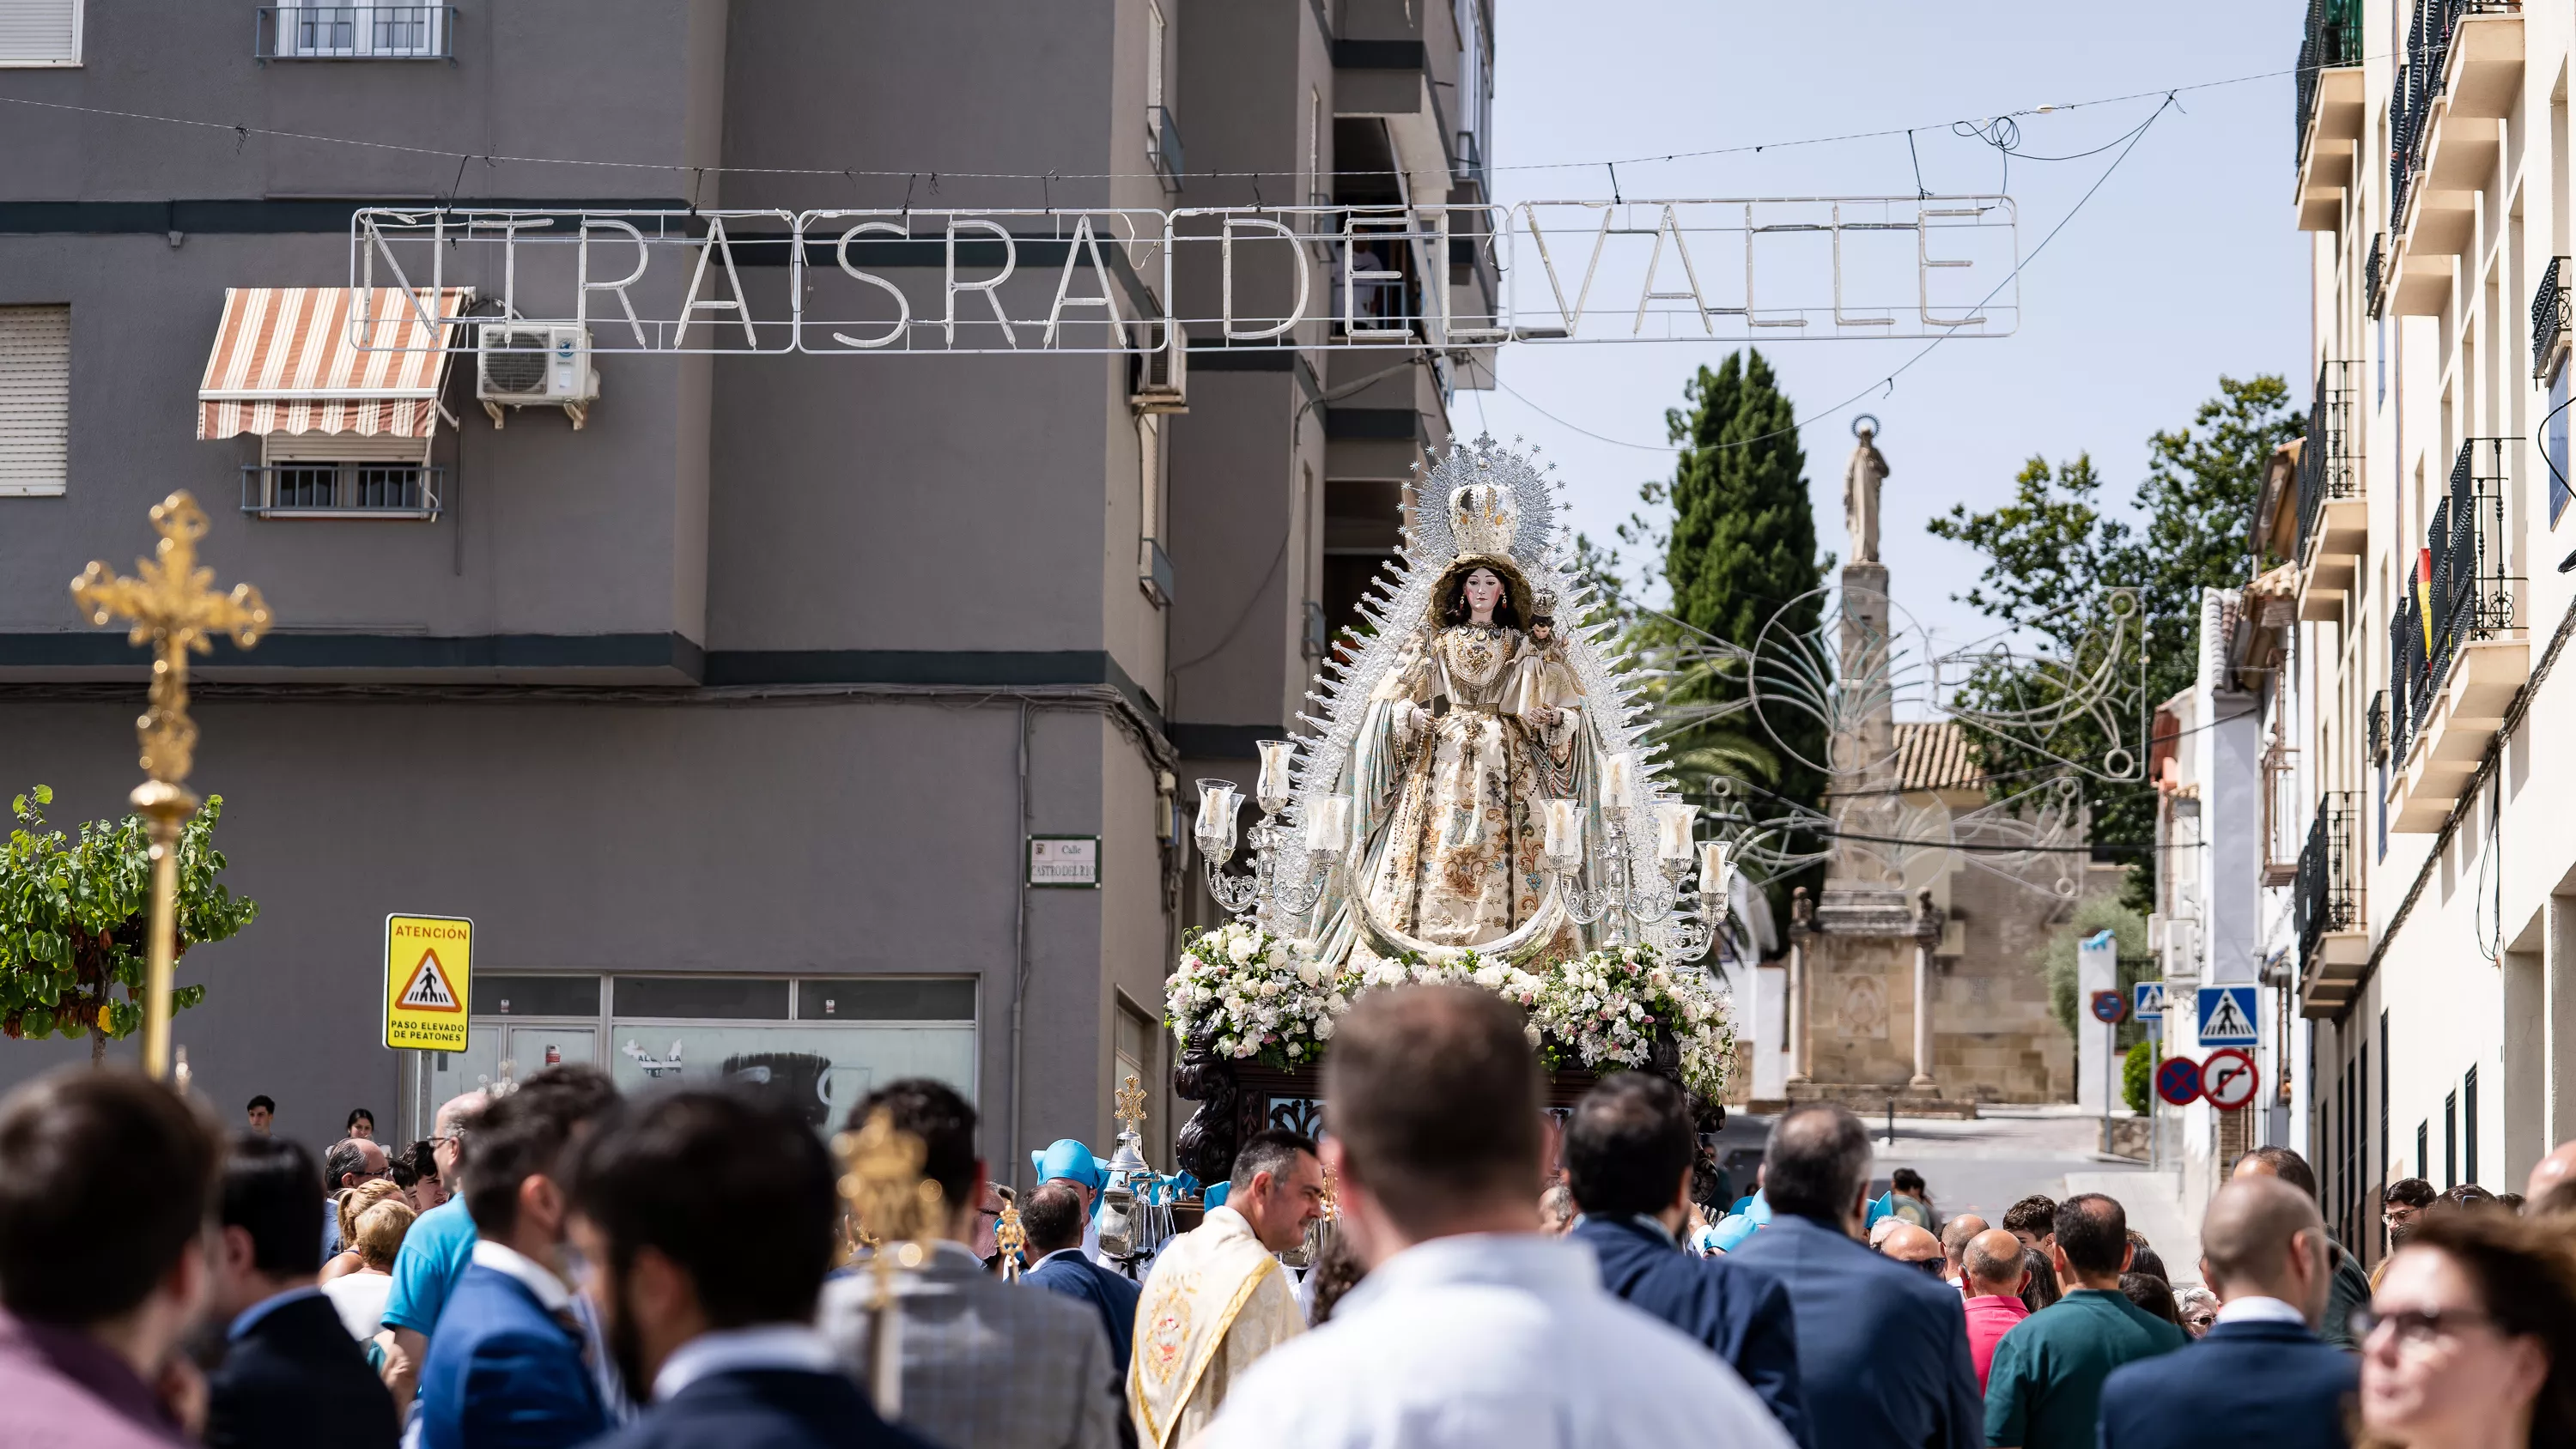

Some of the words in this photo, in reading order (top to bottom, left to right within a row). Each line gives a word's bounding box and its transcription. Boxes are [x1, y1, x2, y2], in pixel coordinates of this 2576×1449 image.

[363, 213, 756, 349] NTRA
[832, 214, 1128, 349] SRA
[1223, 211, 1508, 341] DEL
[1523, 204, 1988, 338] VALLE
[1061, 845, 1081, 854] Calle
[1031, 864, 1060, 876] CASTRO
[1062, 864, 1079, 876] DEL
[395, 925, 468, 940] ATENCIÓN
[391, 1020, 417, 1029] PASO
[421, 1022, 465, 1033] ELEVADO
[393, 1030, 406, 1039] DE
[410, 1032, 461, 1042] PEATONES
